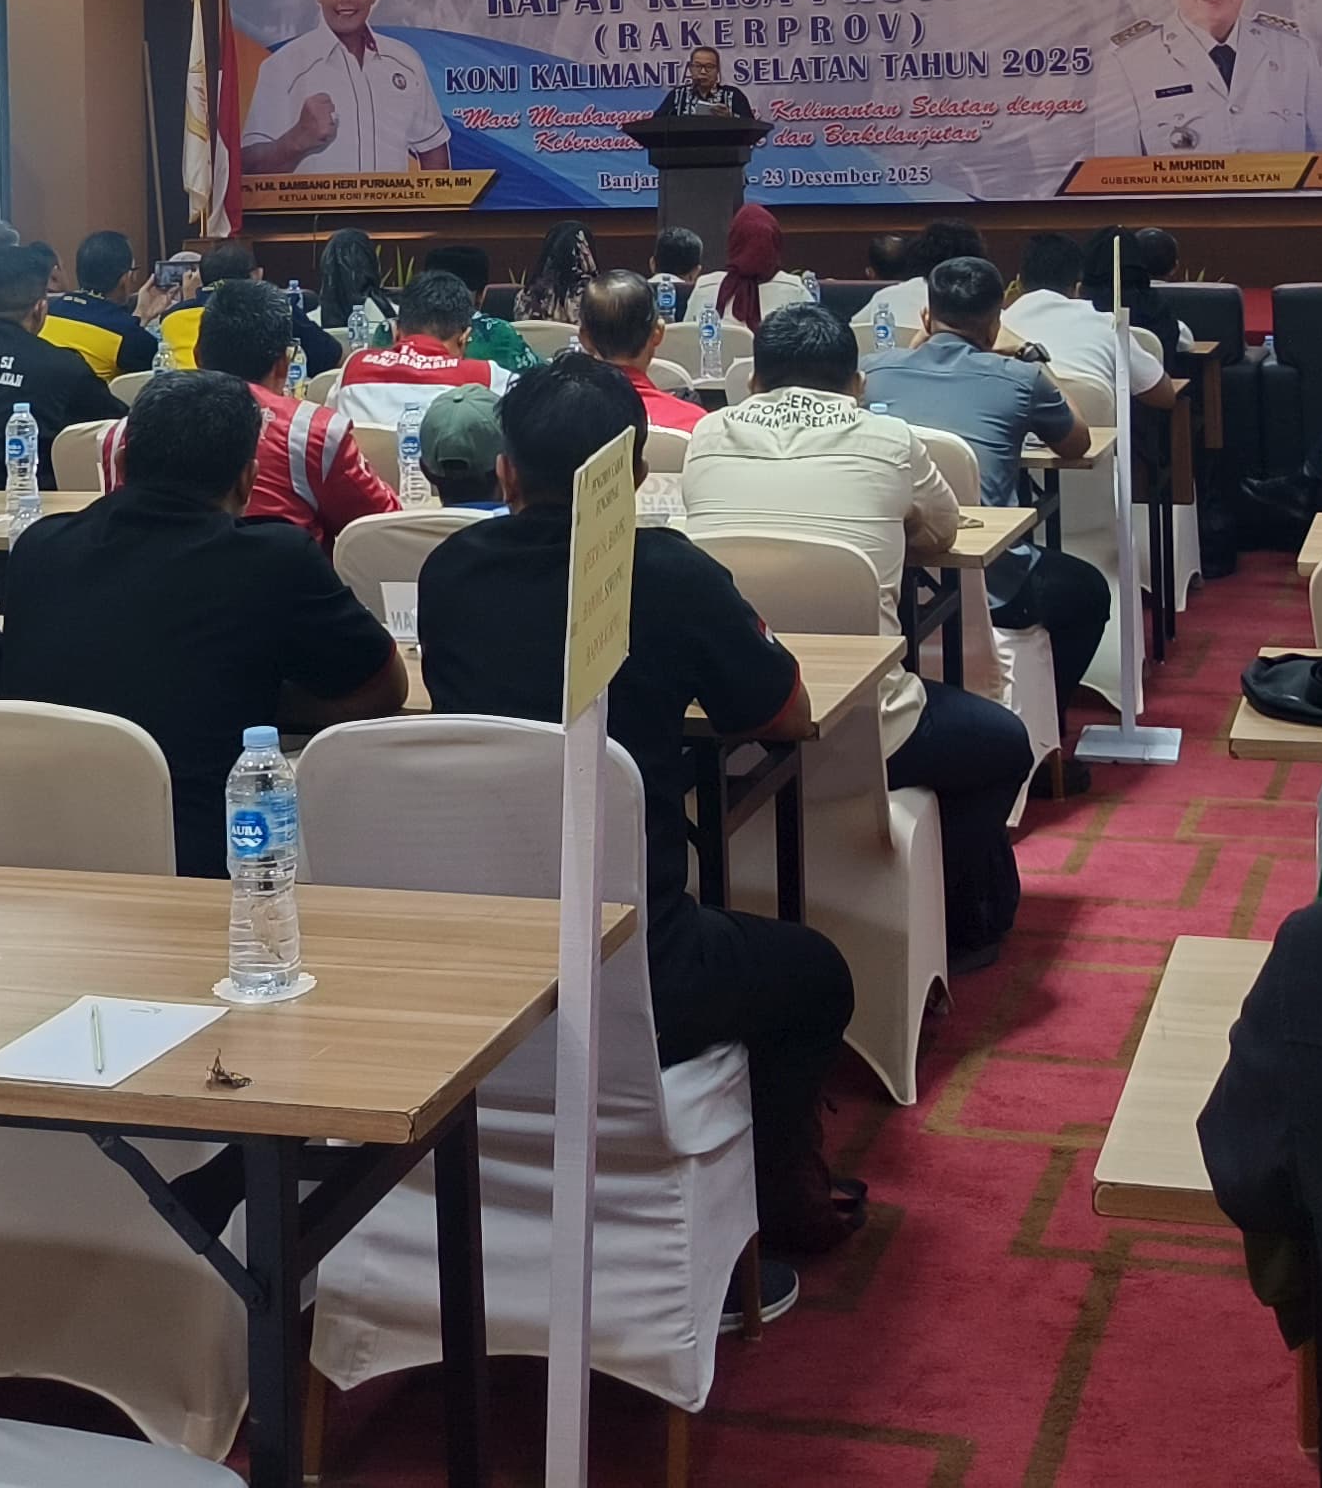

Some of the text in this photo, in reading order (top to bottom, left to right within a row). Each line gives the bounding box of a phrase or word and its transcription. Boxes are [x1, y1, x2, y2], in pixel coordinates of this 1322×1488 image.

[594, 12, 926, 58] (RAKERPROV)
[445, 46, 1092, 93] KONI KALIMANTA SELATAN TAHUN 2025
[771, 99, 900, 121] Kalimantan
[909, 96, 998, 118] Selatan
[1006, 96, 1087, 120] dengan
[773, 128, 814, 146] dan
[1153, 160, 1226, 171] H. MUHIDIN
[279, 180, 330, 191] BAMBANG
[333, 179, 357, 190] HERI
[416, 177, 433, 190] ST,
[435, 177, 452, 189] SH,
[455, 177, 472, 187] MH
[598, 171, 659, 192] Banjar
[762, 168, 784, 186] 23
[790, 168, 881, 186] Desember
[888, 166, 932, 184] 2025
[1101, 173, 1281, 185] GUBERNUR KALIMANTAN SELATAN
[278, 193, 308, 202] KETUA
[311, 193, 337, 201] UMUM
[340, 193, 361, 201] KONI
[805, 413, 856, 428] SELATAN
